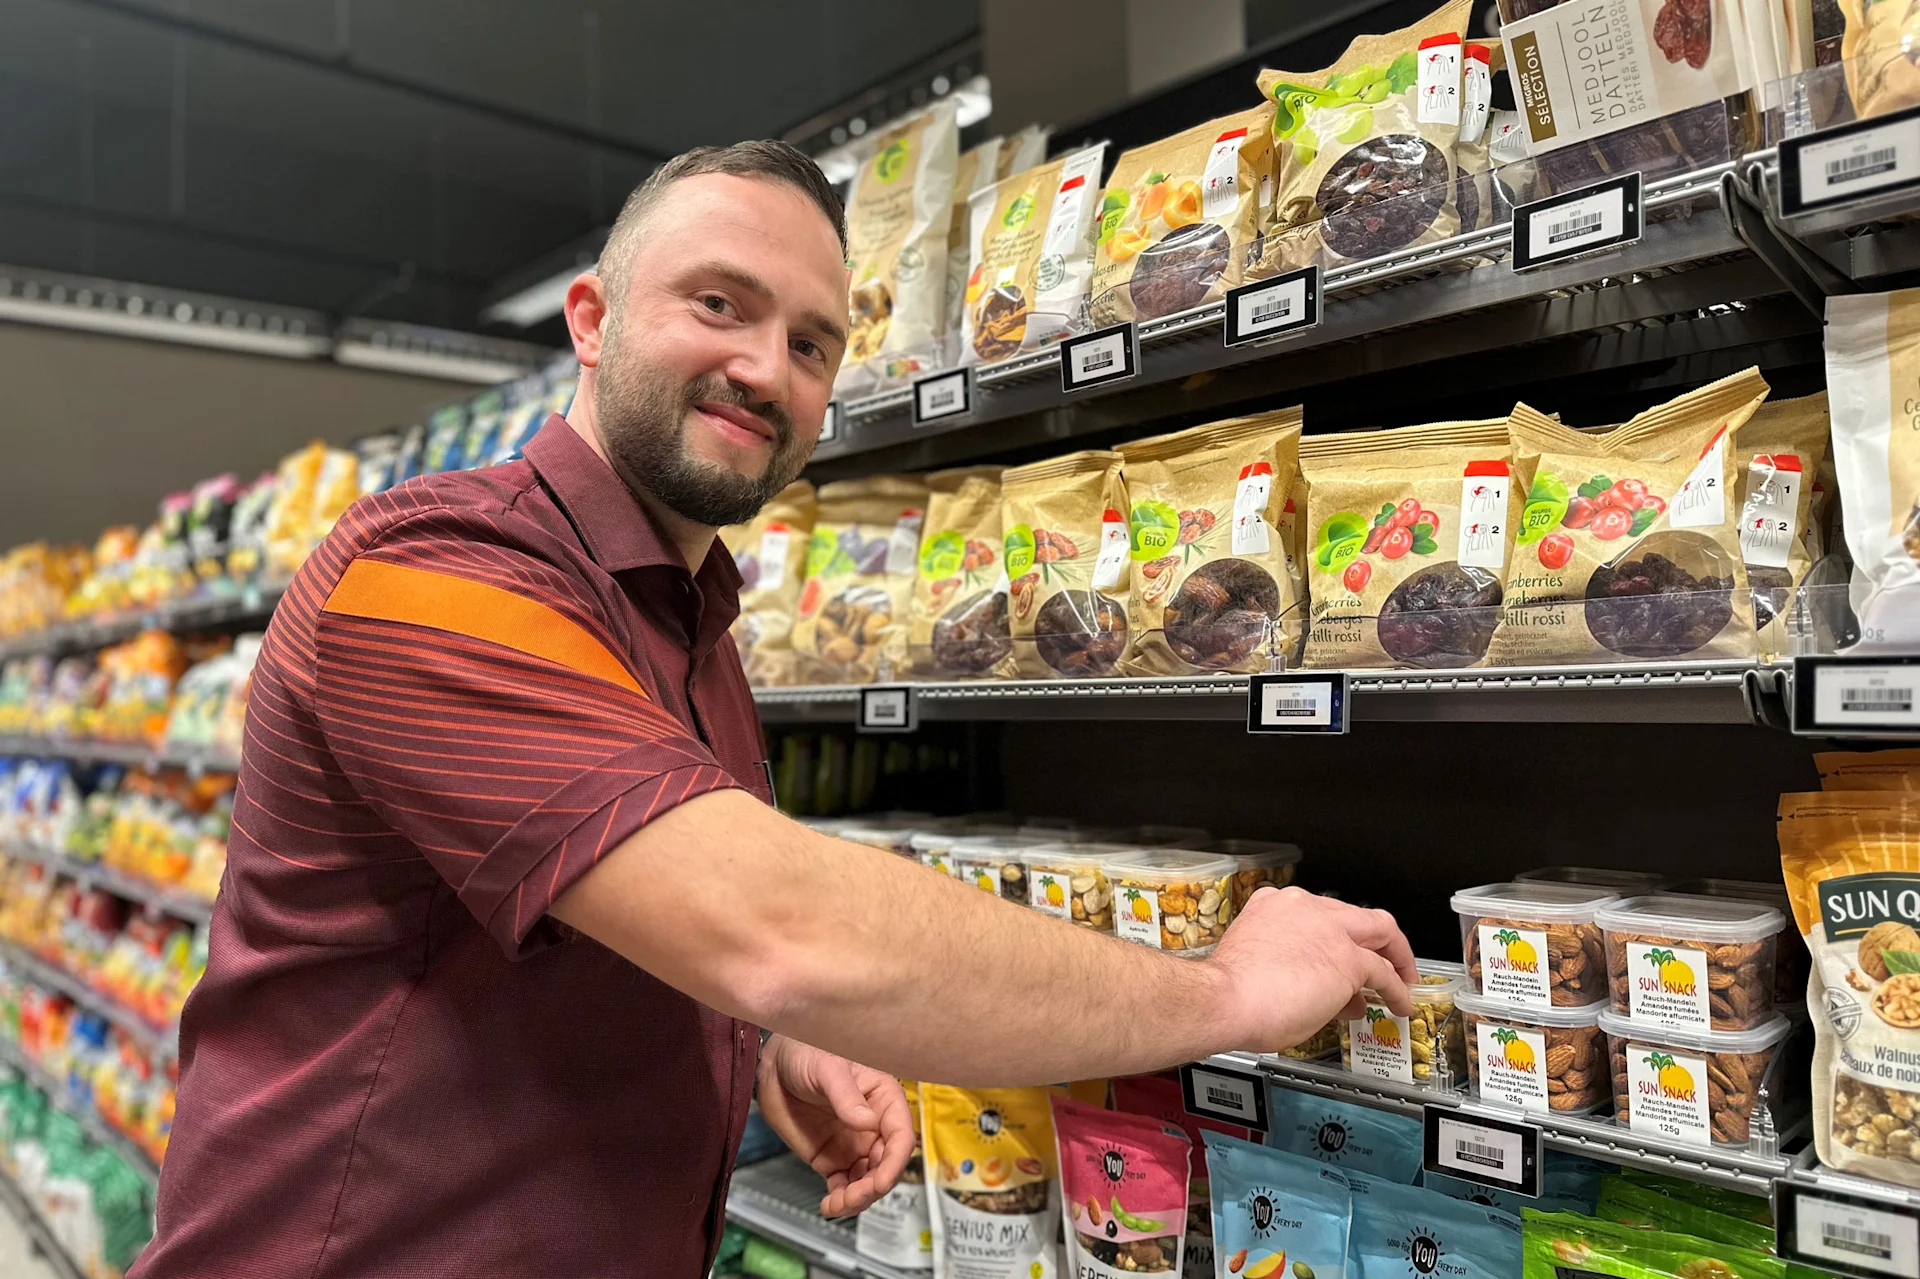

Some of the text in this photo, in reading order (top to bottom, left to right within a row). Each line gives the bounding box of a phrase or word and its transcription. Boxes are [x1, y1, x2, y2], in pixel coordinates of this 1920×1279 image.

[1572, 12, 1606, 124] MEDJOOL
[1588, 5, 1626, 118] DATTELN
[1448, 87, 1455, 95] 2
[1521, 73, 1534, 107] MIGROS
[1524, 45, 1551, 125] SÉLECTION
[1622, 67, 1638, 113] DATTES
[1631, 60, 1646, 110] DATTERI
[1478, 103, 1485, 112] 2
[1227, 176, 1233, 184] 2
[1104, 218, 1118, 231] BIO
[1706, 478, 1715, 487] 2
[1495, 490, 1500, 498] 1
[1784, 485, 1790, 494] 1
[1529, 514, 1550, 527] BIO
[1778, 522, 1787, 531] 2
[1492, 525, 1499, 534] 2
[1144, 536, 1166, 547] BIO
[1335, 547, 1354, 558] BIO
[1011, 557, 1028, 567] BIO
[1532, 611, 1565, 625] rossi
[1334, 630, 1362, 642] rossi
[1489, 657, 1516, 666] 150g
[1036, 896, 1048, 905] SUN
[1827, 890, 1891, 923] SUN
[1121, 911, 1153, 924] SUN SNACK
[1489, 956, 1540, 974] SUN SNACK
[1491, 979, 1542, 990] Amandes fumées
[1493, 972, 1539, 984] Rauch-Mandeln
[1487, 985, 1546, 998] Mandorle affumicate
[1638, 977, 1697, 997] SUN SNACK
[1643, 994, 1696, 1007] Rauch-Mandeln
[1641, 1001, 1699, 1014] Amandes fumées
[1636, 1008, 1668, 1018] Mandorle
[1669, 1013, 1705, 1023] affumicate
[1357, 1032, 1402, 1050] SUN SNACK
[1361, 1045, 1401, 1057] Curry-Cashews
[1377, 1054, 1392, 1062] cajou
[1392, 1057, 1407, 1065] Curry
[1386, 1062, 1402, 1070] Curry
[1487, 1054, 1537, 1075] SUN SNACK
[1373, 1068, 1390, 1077] 125g
[1491, 1069, 1537, 1083] Rauch-Mandeln
[1877, 1063, 1893, 1078] de
[1484, 1082, 1544, 1098] Mandorle affumicate
[1489, 1076, 1539, 1091] Amandes fumées
[1638, 1080, 1697, 1103] SUN SNACK
[1505, 1094, 1523, 1105] 125g
[1642, 1097, 1696, 1112] Rauch-Mandeln
[1640, 1104, 1699, 1120] Amandes fumées
[1635, 1110, 1705, 1129] Mandorle affumicate
[1659, 1123, 1680, 1135] 125g
[1322, 1125, 1344, 1149] YOU
[1255, 1202, 1270, 1224] YOU
[1273, 1216, 1302, 1229] EVERY DAY
[1387, 1238, 1411, 1253] GOOD FOR
[1415, 1241, 1435, 1268] YOU
[1437, 1260, 1467, 1276] EVERY DAY
